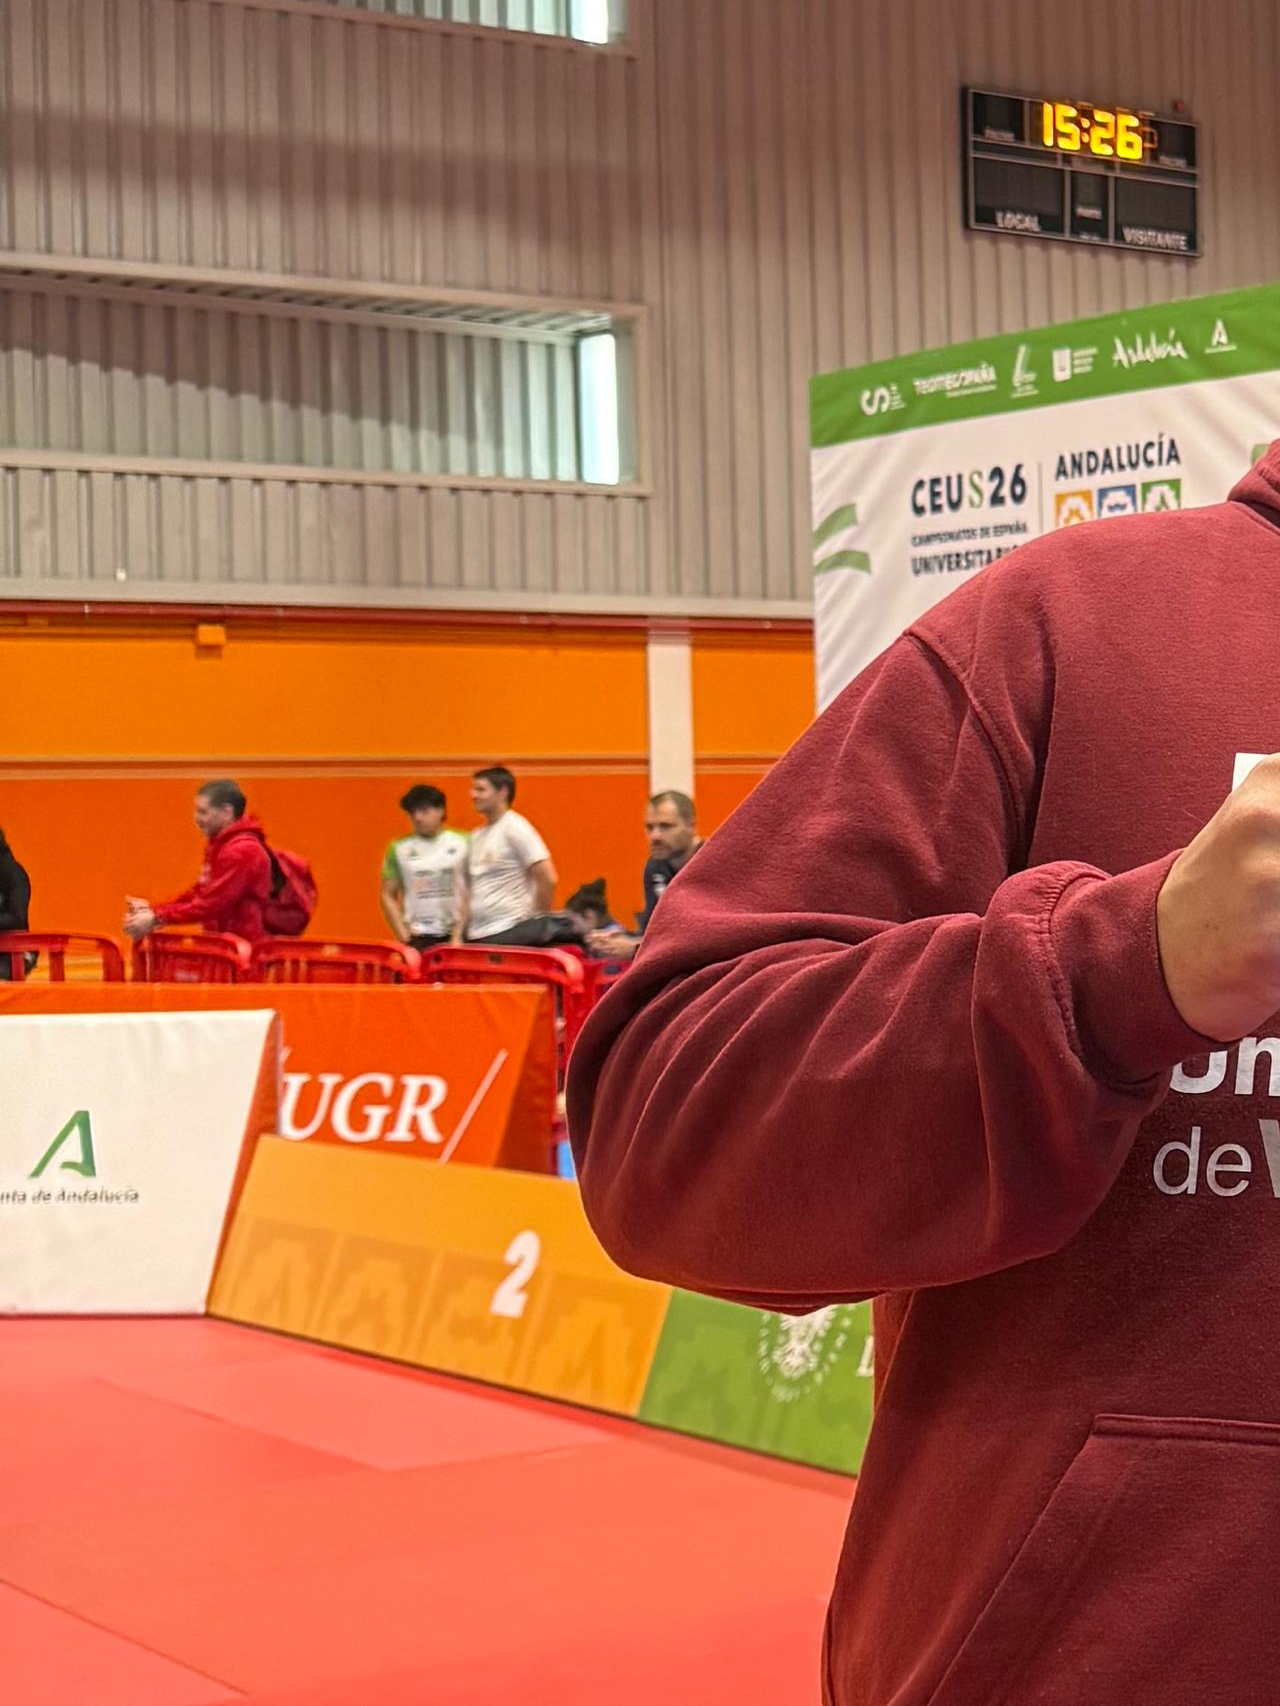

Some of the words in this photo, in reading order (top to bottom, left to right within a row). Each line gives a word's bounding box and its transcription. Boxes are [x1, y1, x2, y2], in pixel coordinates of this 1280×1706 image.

[1043, 100, 1143, 160] 15:26
[1055, 434, 1181, 481] ANDALUCÍA
[911, 463, 1027, 517] CEUS26
[279, 1072, 448, 1144] UGR
[490, 1229, 540, 1318] 2
